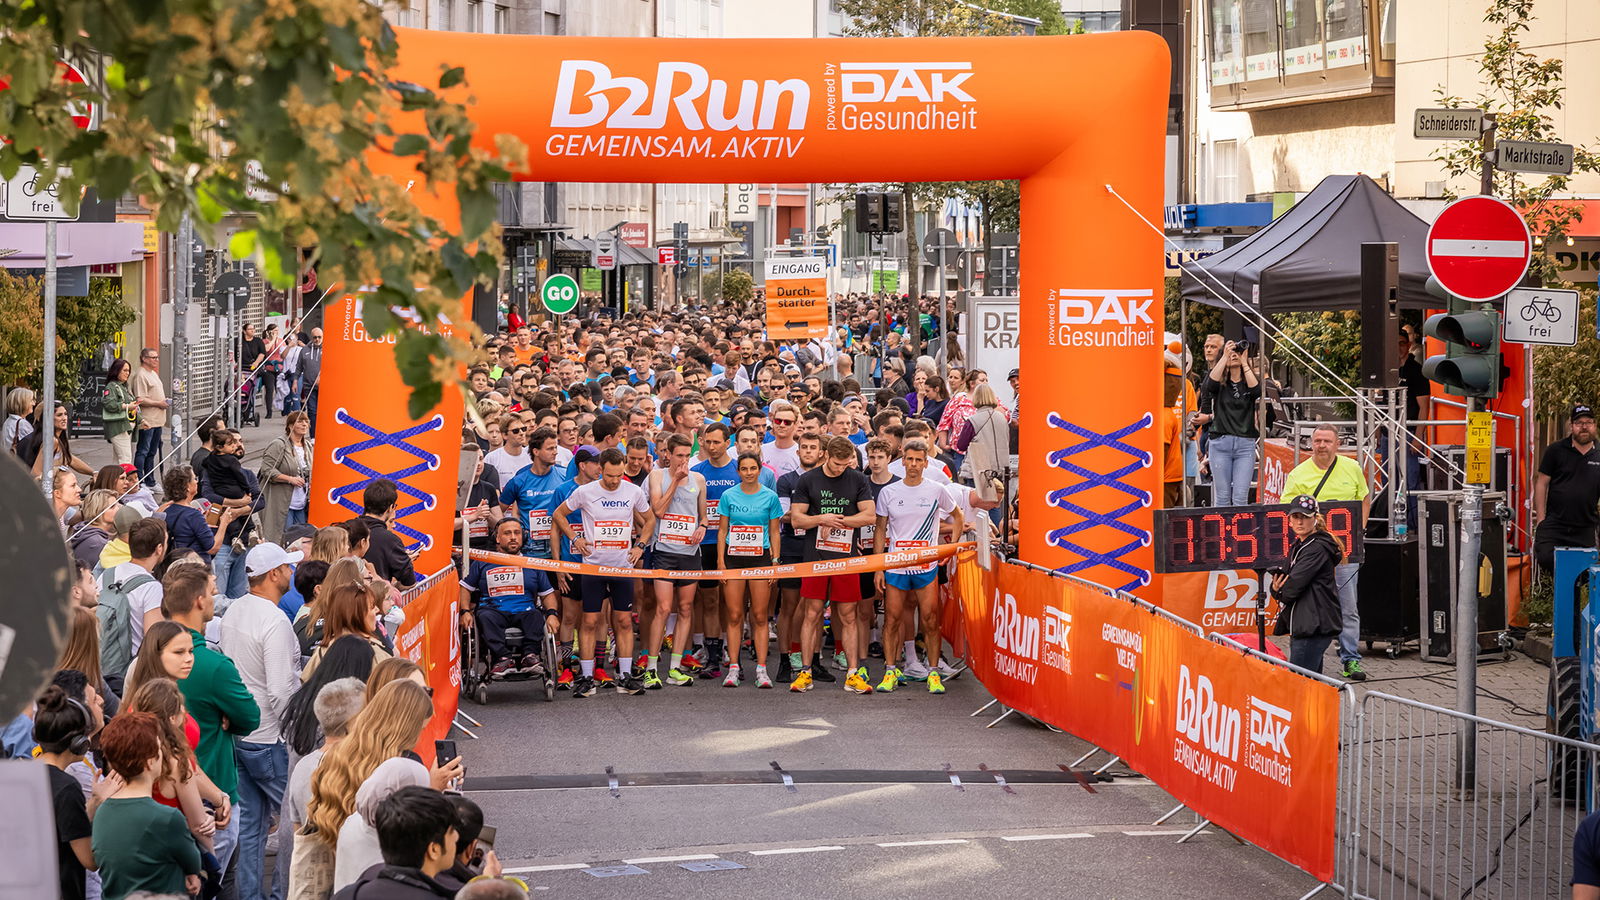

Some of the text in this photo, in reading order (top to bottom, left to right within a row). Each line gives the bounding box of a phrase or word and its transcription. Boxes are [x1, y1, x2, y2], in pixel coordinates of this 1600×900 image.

[840, 62, 976, 102] DAK
[550, 60, 810, 131] B2Run
[825, 63, 837, 130] powered by
[841, 104, 977, 130] Gesundheit
[1420, 115, 1477, 131] Schneiderstr.
[1505, 147, 1564, 166] Marktstraße
[32, 200, 54, 212] frei
[771, 264, 820, 274] EINGANG
[547, 286, 574, 301] GO
[777, 286, 816, 297] Durch-
[778, 299, 816, 308] starter
[1059, 288, 1154, 325] DAK
[344, 298, 352, 341] powered
[1048, 289, 1056, 346] powered by
[1059, 325, 1154, 347] Gesundheit
[1529, 325, 1552, 337] frei
[1474, 453, 1480, 461] K
[820, 490, 833, 498] Wir
[667, 521, 689, 530] 3051
[493, 573, 517, 581] 5877
[1045, 605, 1072, 652] DAK
[1176, 664, 1241, 762] B2Run
[1250, 695, 1292, 758] DAK
[1249, 742, 1292, 787] Gesundheit
